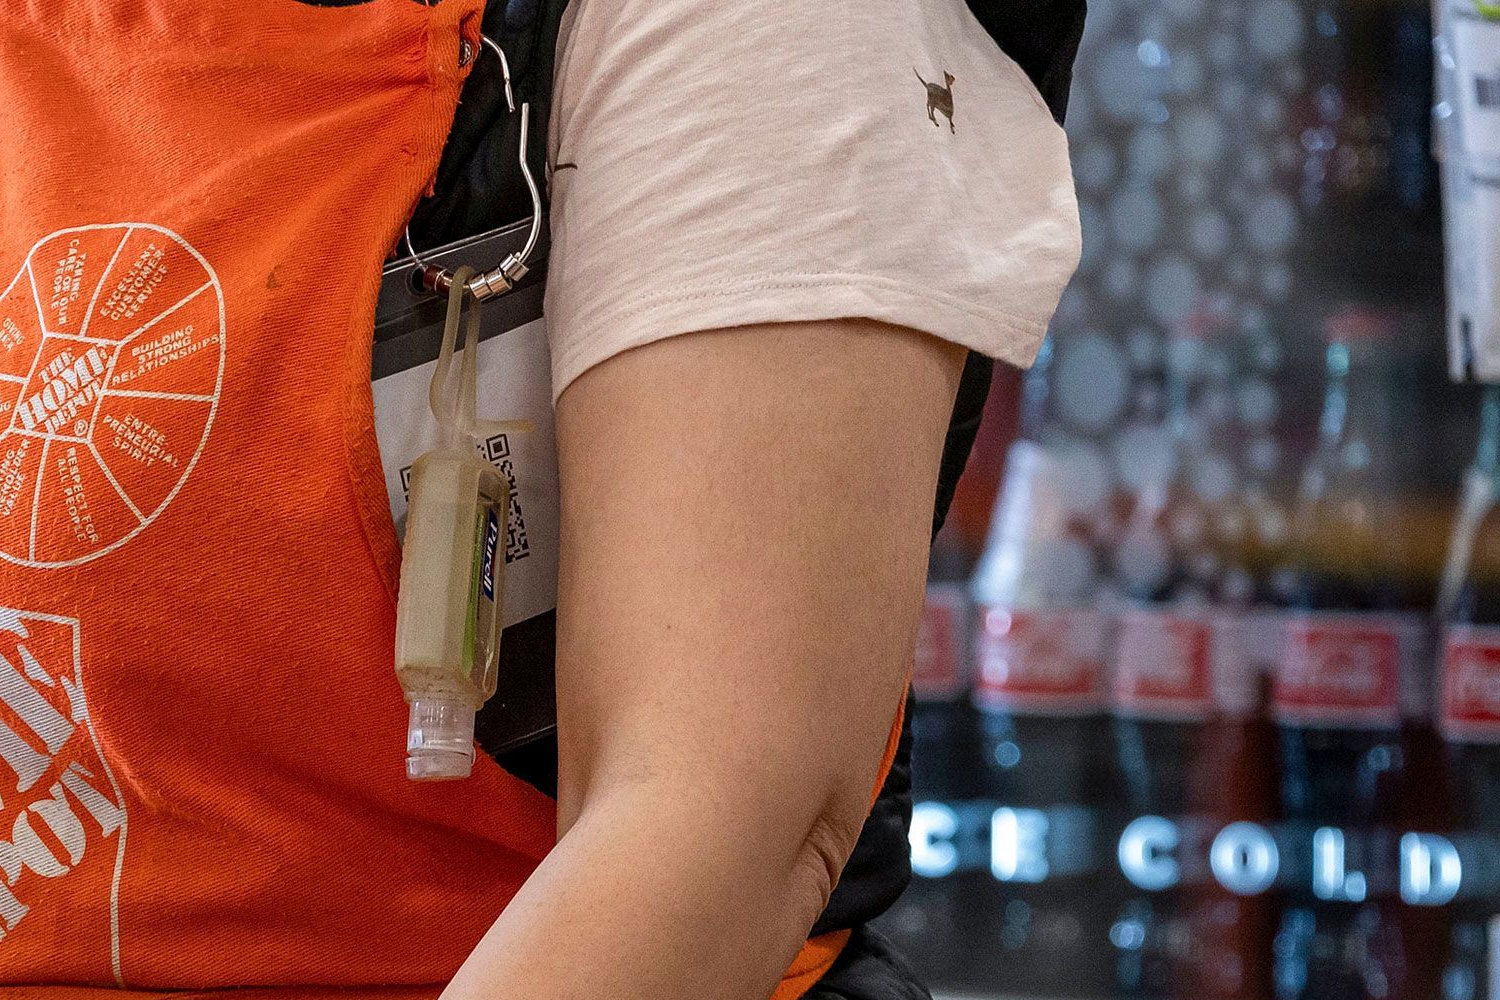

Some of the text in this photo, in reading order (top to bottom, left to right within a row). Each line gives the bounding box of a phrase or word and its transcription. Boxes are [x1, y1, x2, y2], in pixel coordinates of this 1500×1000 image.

[51, 259, 66, 309] PEOPLE
[58, 239, 79, 325] CARE OF OUR
[70, 253, 86, 302] TAKING
[100, 243, 156, 317] EXCELLENT
[110, 249, 165, 321] CUSTOMER
[124, 264, 168, 319] SERVICE
[2, 317, 25, 345] GIVING
[132, 325, 194, 357] BUILDING
[138, 338, 192, 364] STRONG
[39, 347, 75, 385] THE
[111, 335, 220, 386] RELATIONSHIPS
[20, 344, 113, 432] HOME
[102, 414, 178, 468] PRENEURIAL
[112, 436, 155, 467] SPIRIT
[0, 472, 26, 516] VALUE
[57, 459, 86, 542] ALL PEOPLE
[67, 447, 98, 544] RESPECT FOR
[484, 522, 498, 592] Purell
[1117, 814, 1462, 906] COLD
